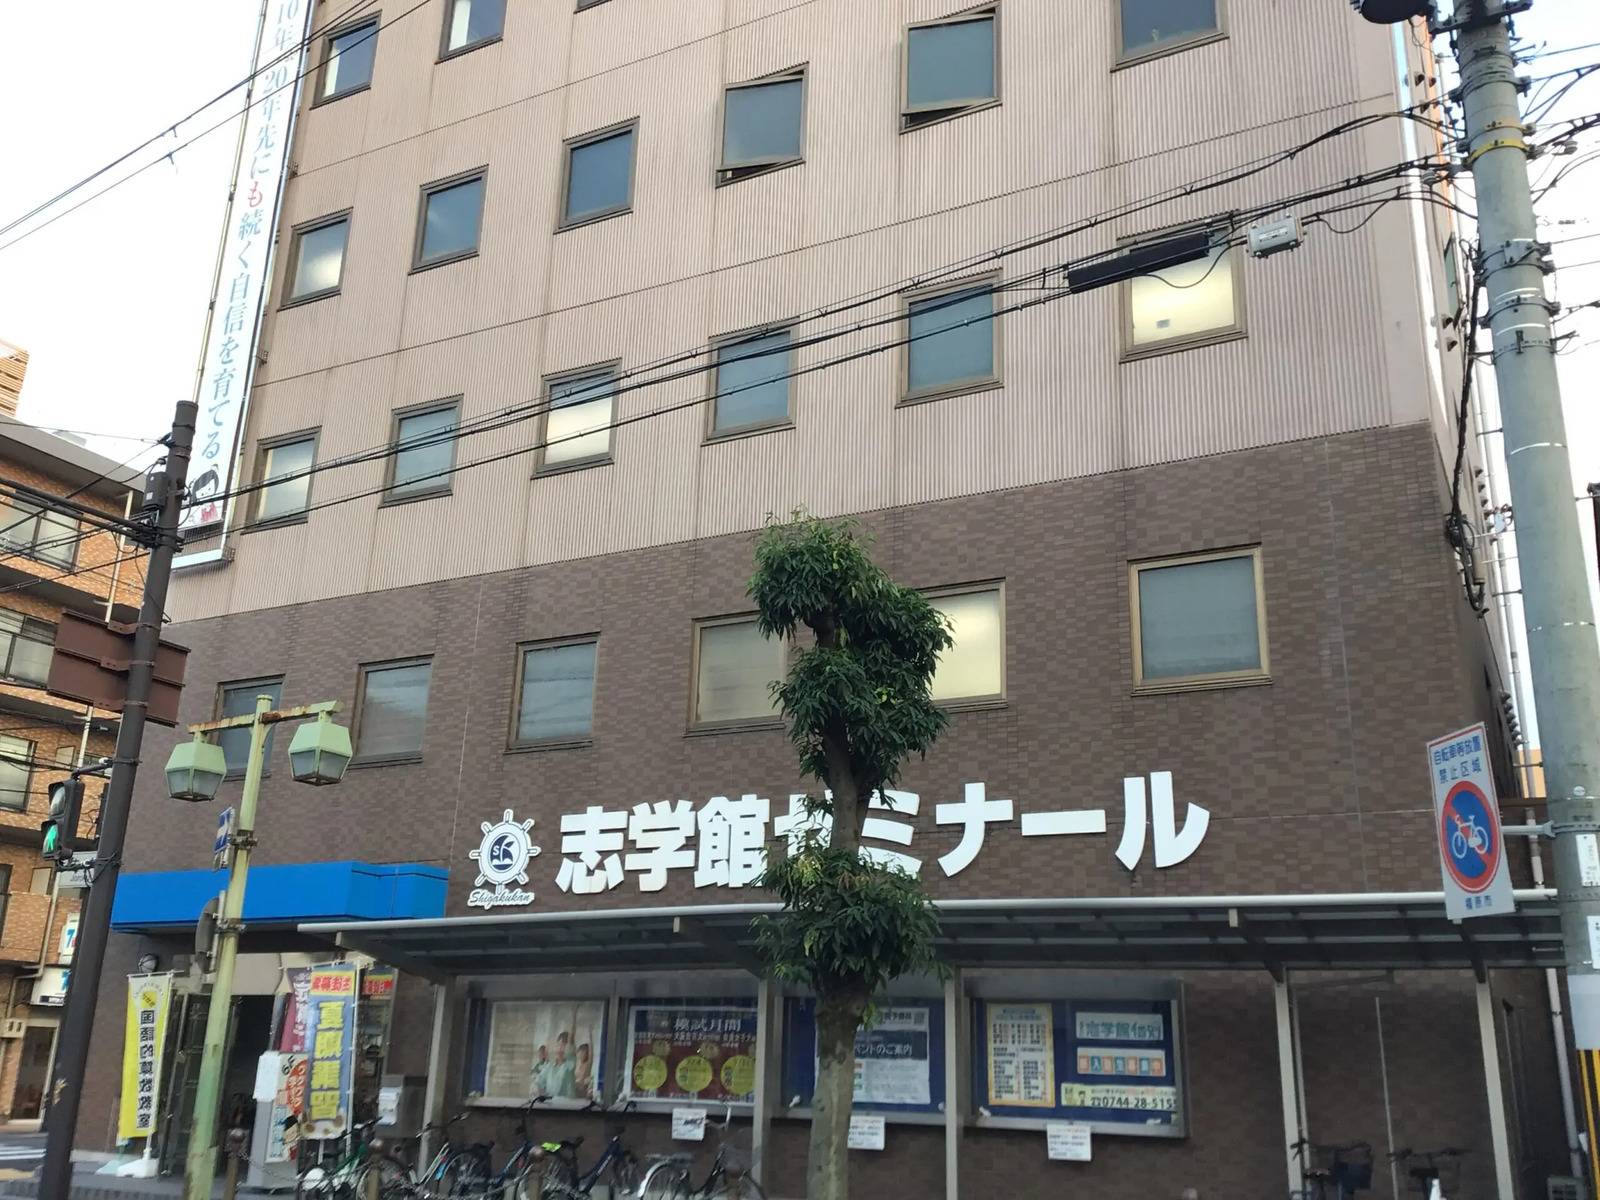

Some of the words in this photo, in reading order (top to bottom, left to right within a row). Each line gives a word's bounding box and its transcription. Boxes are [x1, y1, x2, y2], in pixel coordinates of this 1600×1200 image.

[1434, 735, 1481, 765] 自転車等放置
[1439, 757, 1482, 784] 禁止区域
[468, 889, 533, 908] Shigakukan
